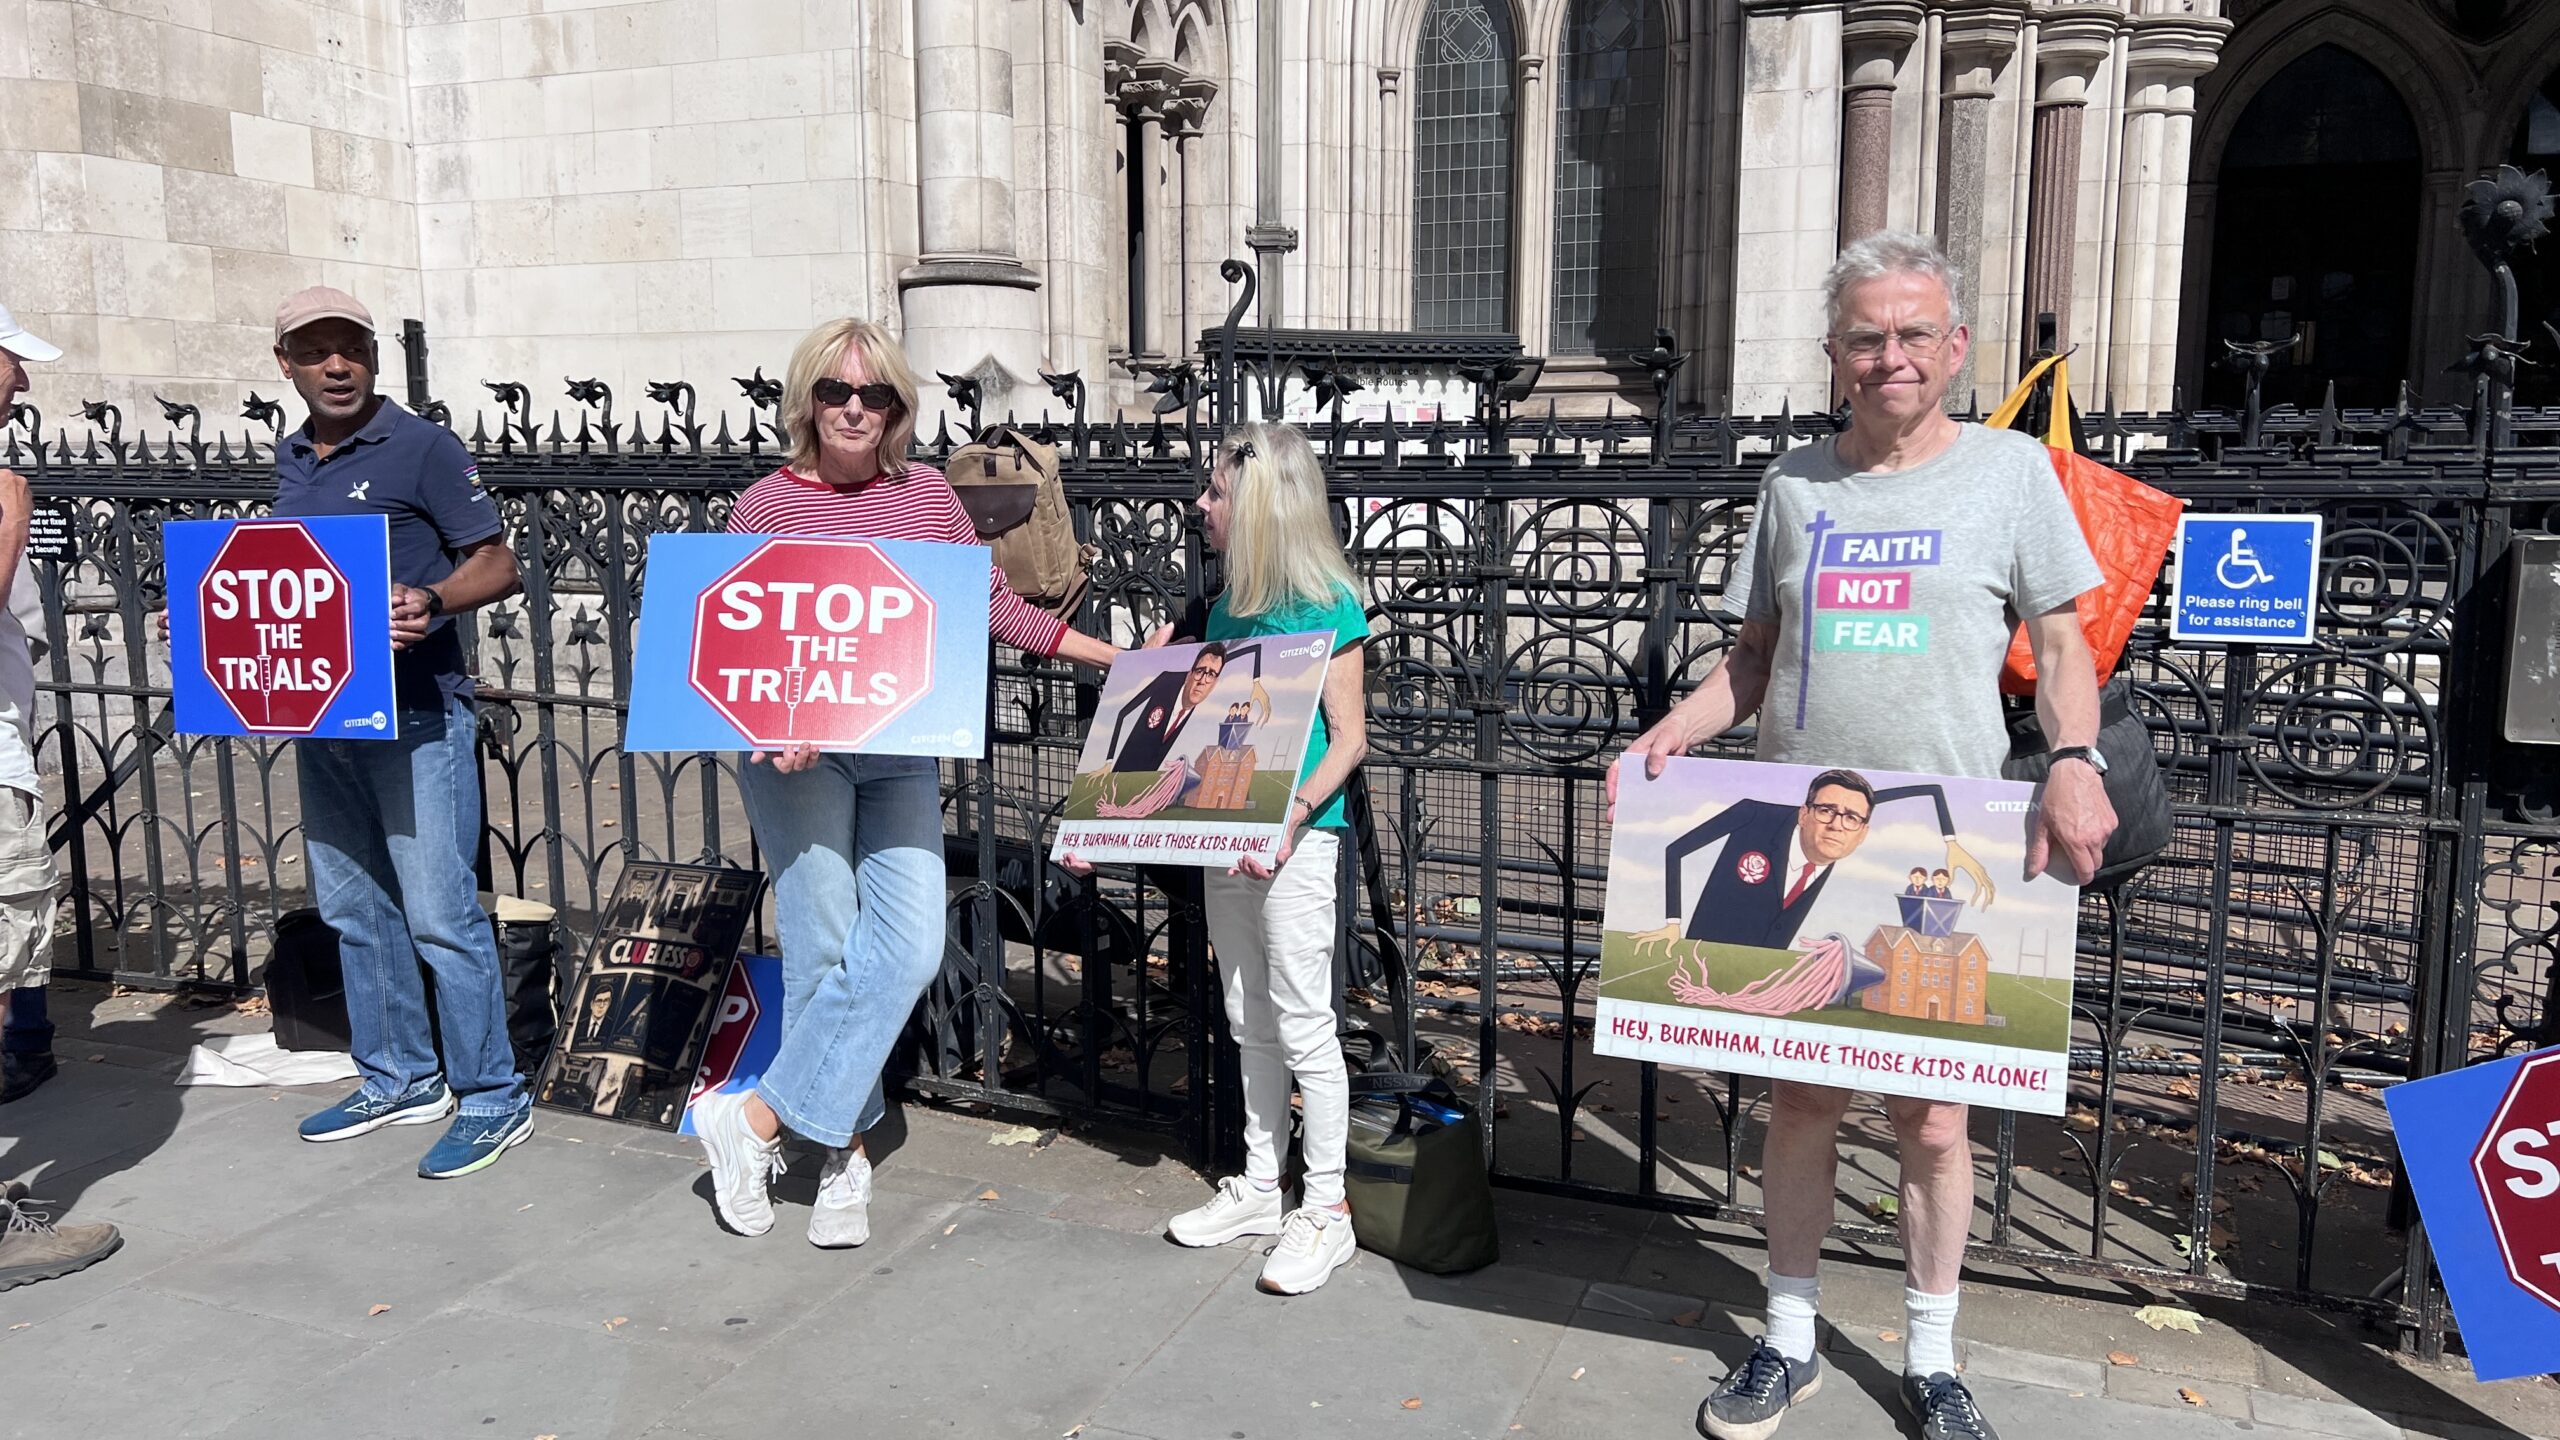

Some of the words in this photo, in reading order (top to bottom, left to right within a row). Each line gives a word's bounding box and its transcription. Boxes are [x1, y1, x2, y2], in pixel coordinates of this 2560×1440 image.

[1385, 366, 1419, 375] Jusce
[35, 545, 61, 555] Security
[39, 536, 67, 544] removed
[1842, 535, 1932, 562] FAITH
[211, 568, 335, 620] STOP
[1837, 578, 1902, 604] NOT
[2185, 595, 2236, 608] Please
[2239, 597, 2270, 612] ring
[2274, 597, 2303, 610] bell
[717, 580, 914, 634] STOP
[1833, 620, 1919, 648] FEAR
[2188, 614, 2211, 626] for
[2213, 615, 2296, 629] assistance
[255, 623, 303, 656] THE
[785, 635, 859, 668] THE
[218, 657, 332, 692] TRIALS
[718, 668, 898, 706] TRIALS
[1062, 832, 1081, 849] HEY,
[1082, 832, 1130, 848] BURNHAM,
[1133, 833, 1162, 848] LEAVE
[1165, 833, 1197, 850] THOSE
[1200, 836, 1228, 850] KIDS
[1229, 836, 1270, 853] ALONE!
[609, 938, 687, 969] CLUELESS
[1612, 1016, 1654, 1043] HEY,
[1660, 1023, 1765, 1058] BURNHAM,
[1772, 1038, 1831, 1064] LEAVE
[1838, 1045, 1905, 1073] THOSE
[1912, 1056, 1966, 1081] KIDS
[1972, 1064, 2048, 1091] ALONE!
